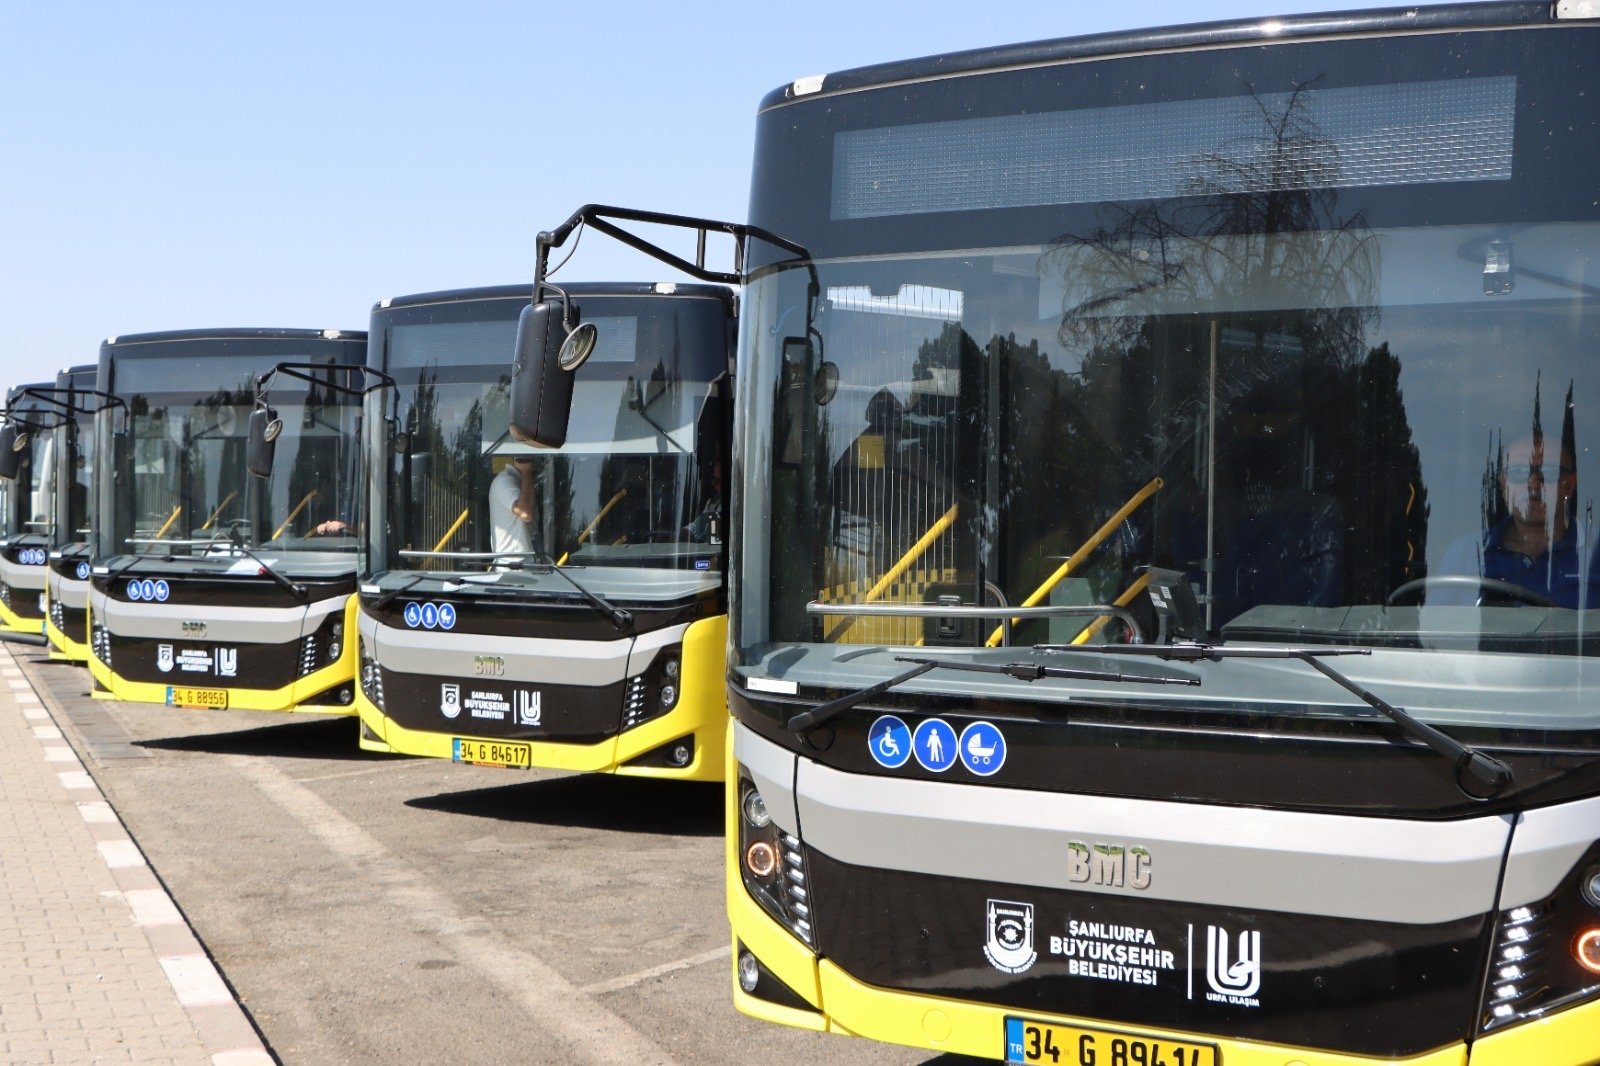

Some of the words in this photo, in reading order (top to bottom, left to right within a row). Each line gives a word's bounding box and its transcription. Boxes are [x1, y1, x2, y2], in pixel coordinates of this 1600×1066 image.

[474, 656, 505, 677] BMC
[173, 690, 183, 702] 34
[187, 691, 193, 703] G
[197, 691, 225, 705] 88956
[461, 743, 473, 758] 34
[479, 744, 486, 760] G
[491, 746, 527, 764] 84617
[1067, 840, 1151, 890] BMC
[1069, 920, 1156, 945] ŞANLIURFA
[1050, 936, 1175, 970] BÜYÜKŞEHİR
[1069, 959, 1157, 986] BELEDİYESİ
[1206, 991, 1227, 1003] URFA
[1228, 995, 1260, 1007] ULAŞIM
[1009, 1042, 1023, 1055] TR
[1025, 1026, 1060, 1063] 34
[1078, 1034, 1096, 1066] G
